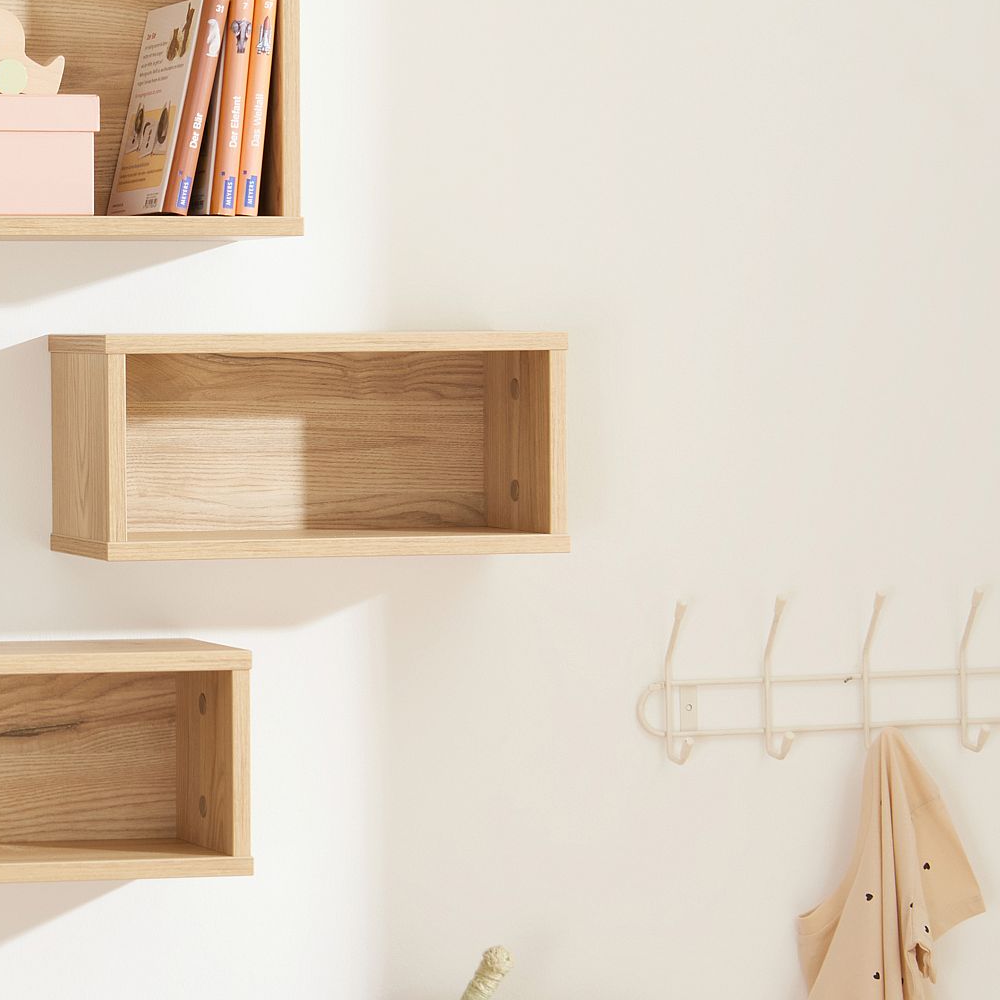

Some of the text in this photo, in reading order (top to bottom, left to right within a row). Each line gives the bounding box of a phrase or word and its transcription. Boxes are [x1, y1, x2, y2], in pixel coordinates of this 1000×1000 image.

[215, 4, 225, 13] 31
[189, 112, 204, 149] Der Bär
[229, 95, 242, 149] Der Elefant
[251, 128, 261, 147] Das
[180, 181, 190, 206] MEYERS
[225, 181, 233, 206] MEYERS
[247, 180, 255, 205] MEYERS
